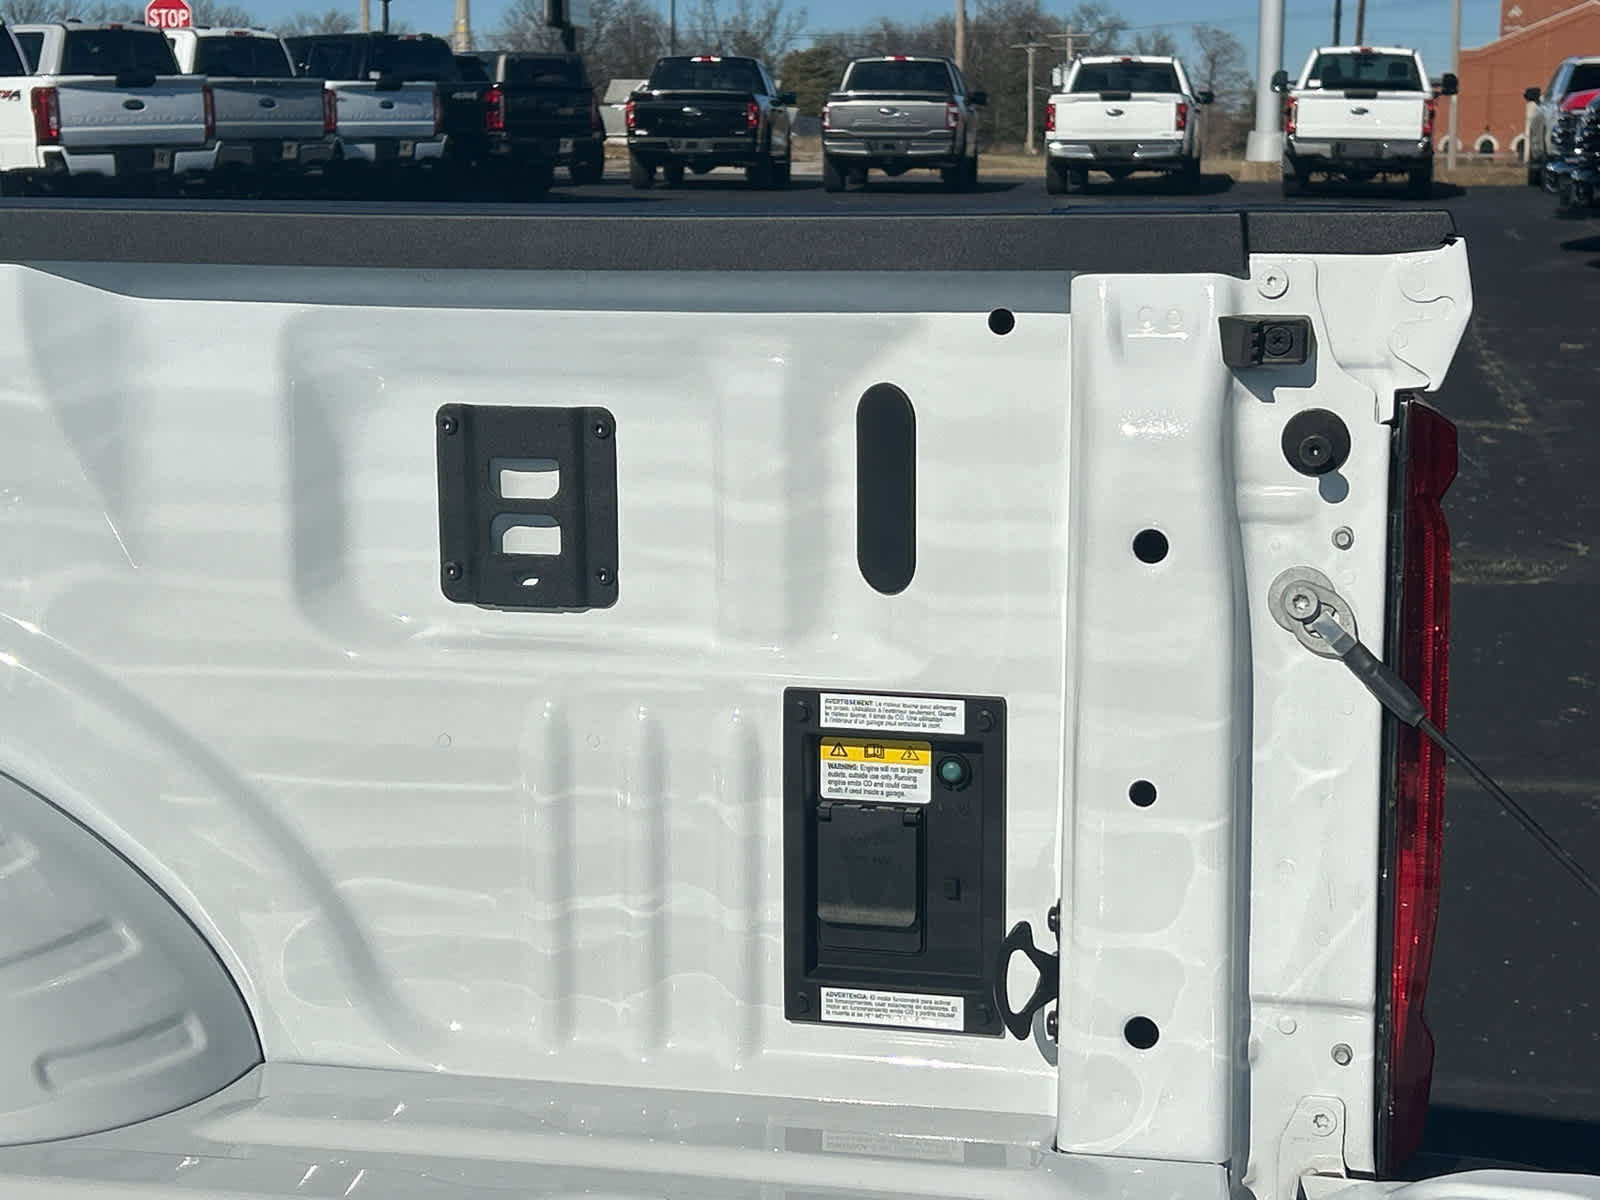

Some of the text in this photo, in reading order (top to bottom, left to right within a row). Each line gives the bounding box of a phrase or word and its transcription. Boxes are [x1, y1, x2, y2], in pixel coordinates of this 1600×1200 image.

[149, 8, 188, 27] STOP
[827, 762, 858, 770] WARNING:
[860, 764, 879, 773] Engine
[907, 767, 923, 775] power
[827, 778, 846, 786] engine
[894, 774, 917, 783] Running
